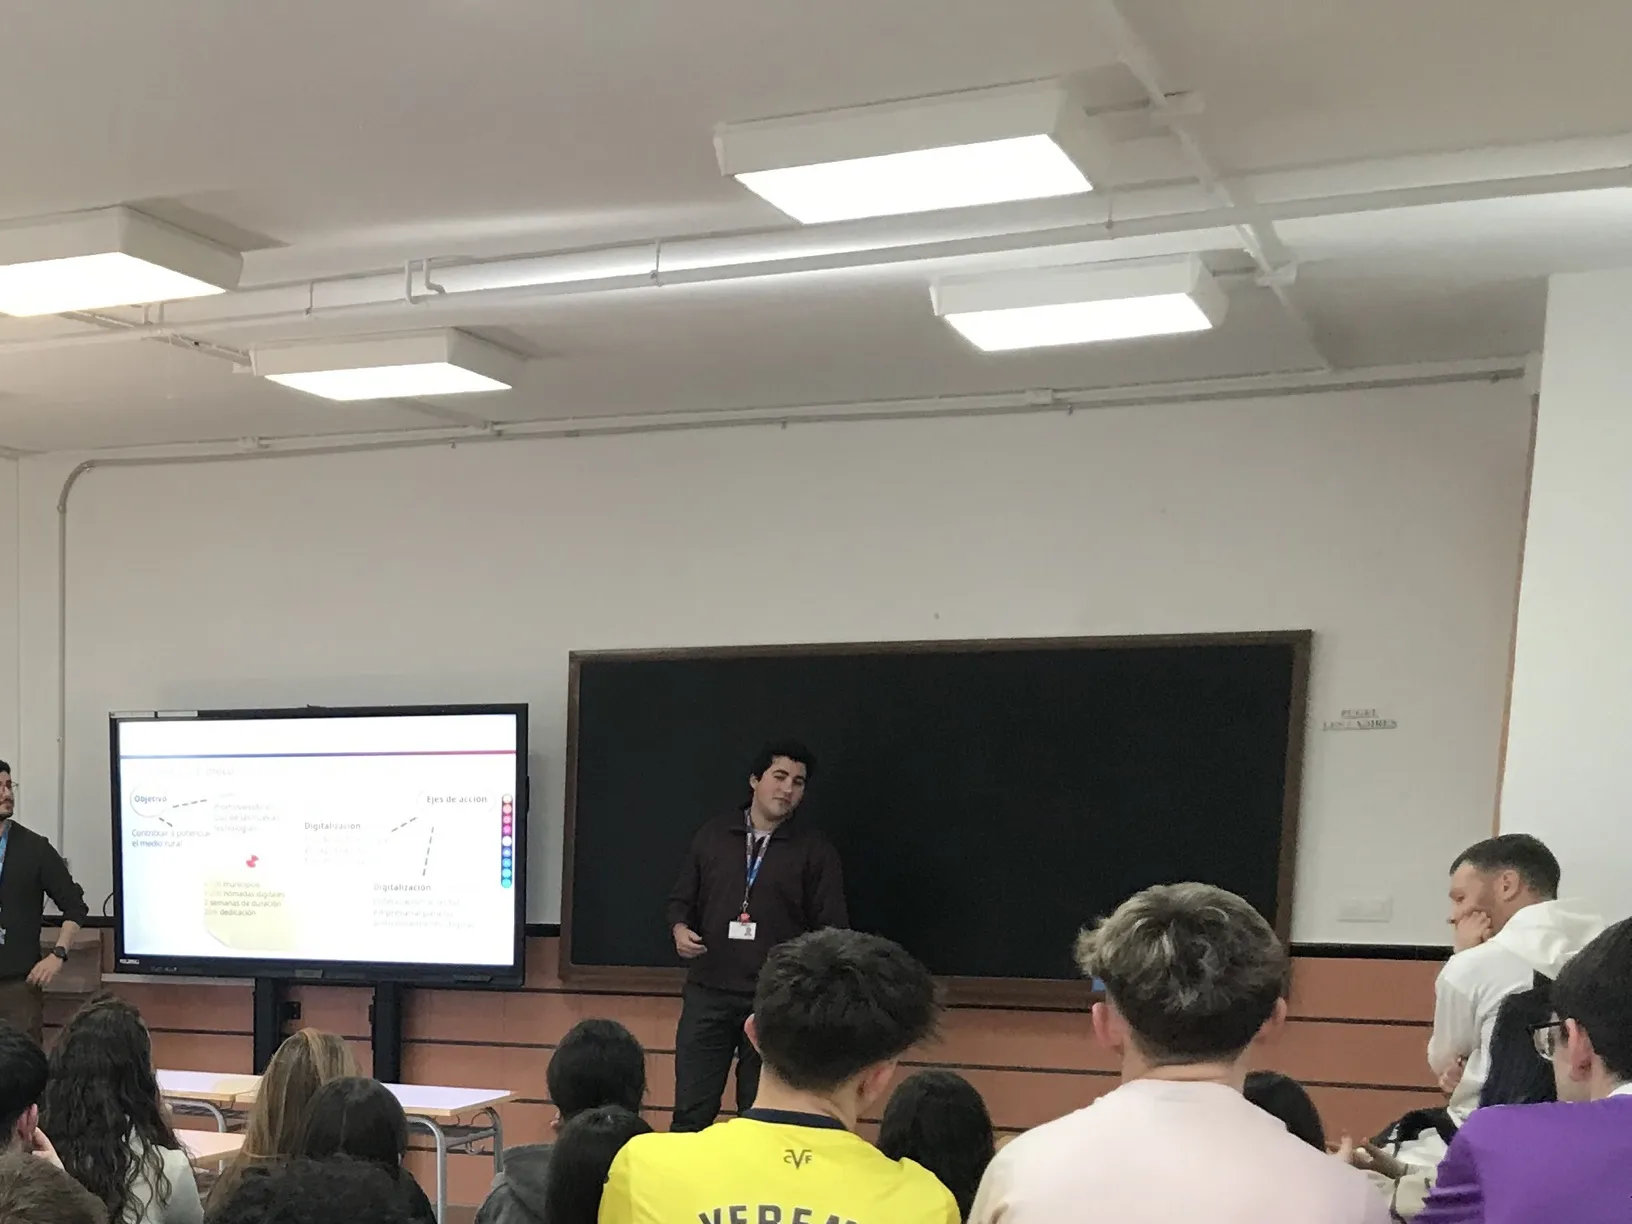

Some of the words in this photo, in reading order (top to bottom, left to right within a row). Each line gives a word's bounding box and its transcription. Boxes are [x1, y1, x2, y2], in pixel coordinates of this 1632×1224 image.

[134, 795, 167, 804] Objetivo
[427, 795, 444, 805] Ejes
[446, 795, 457, 803] de
